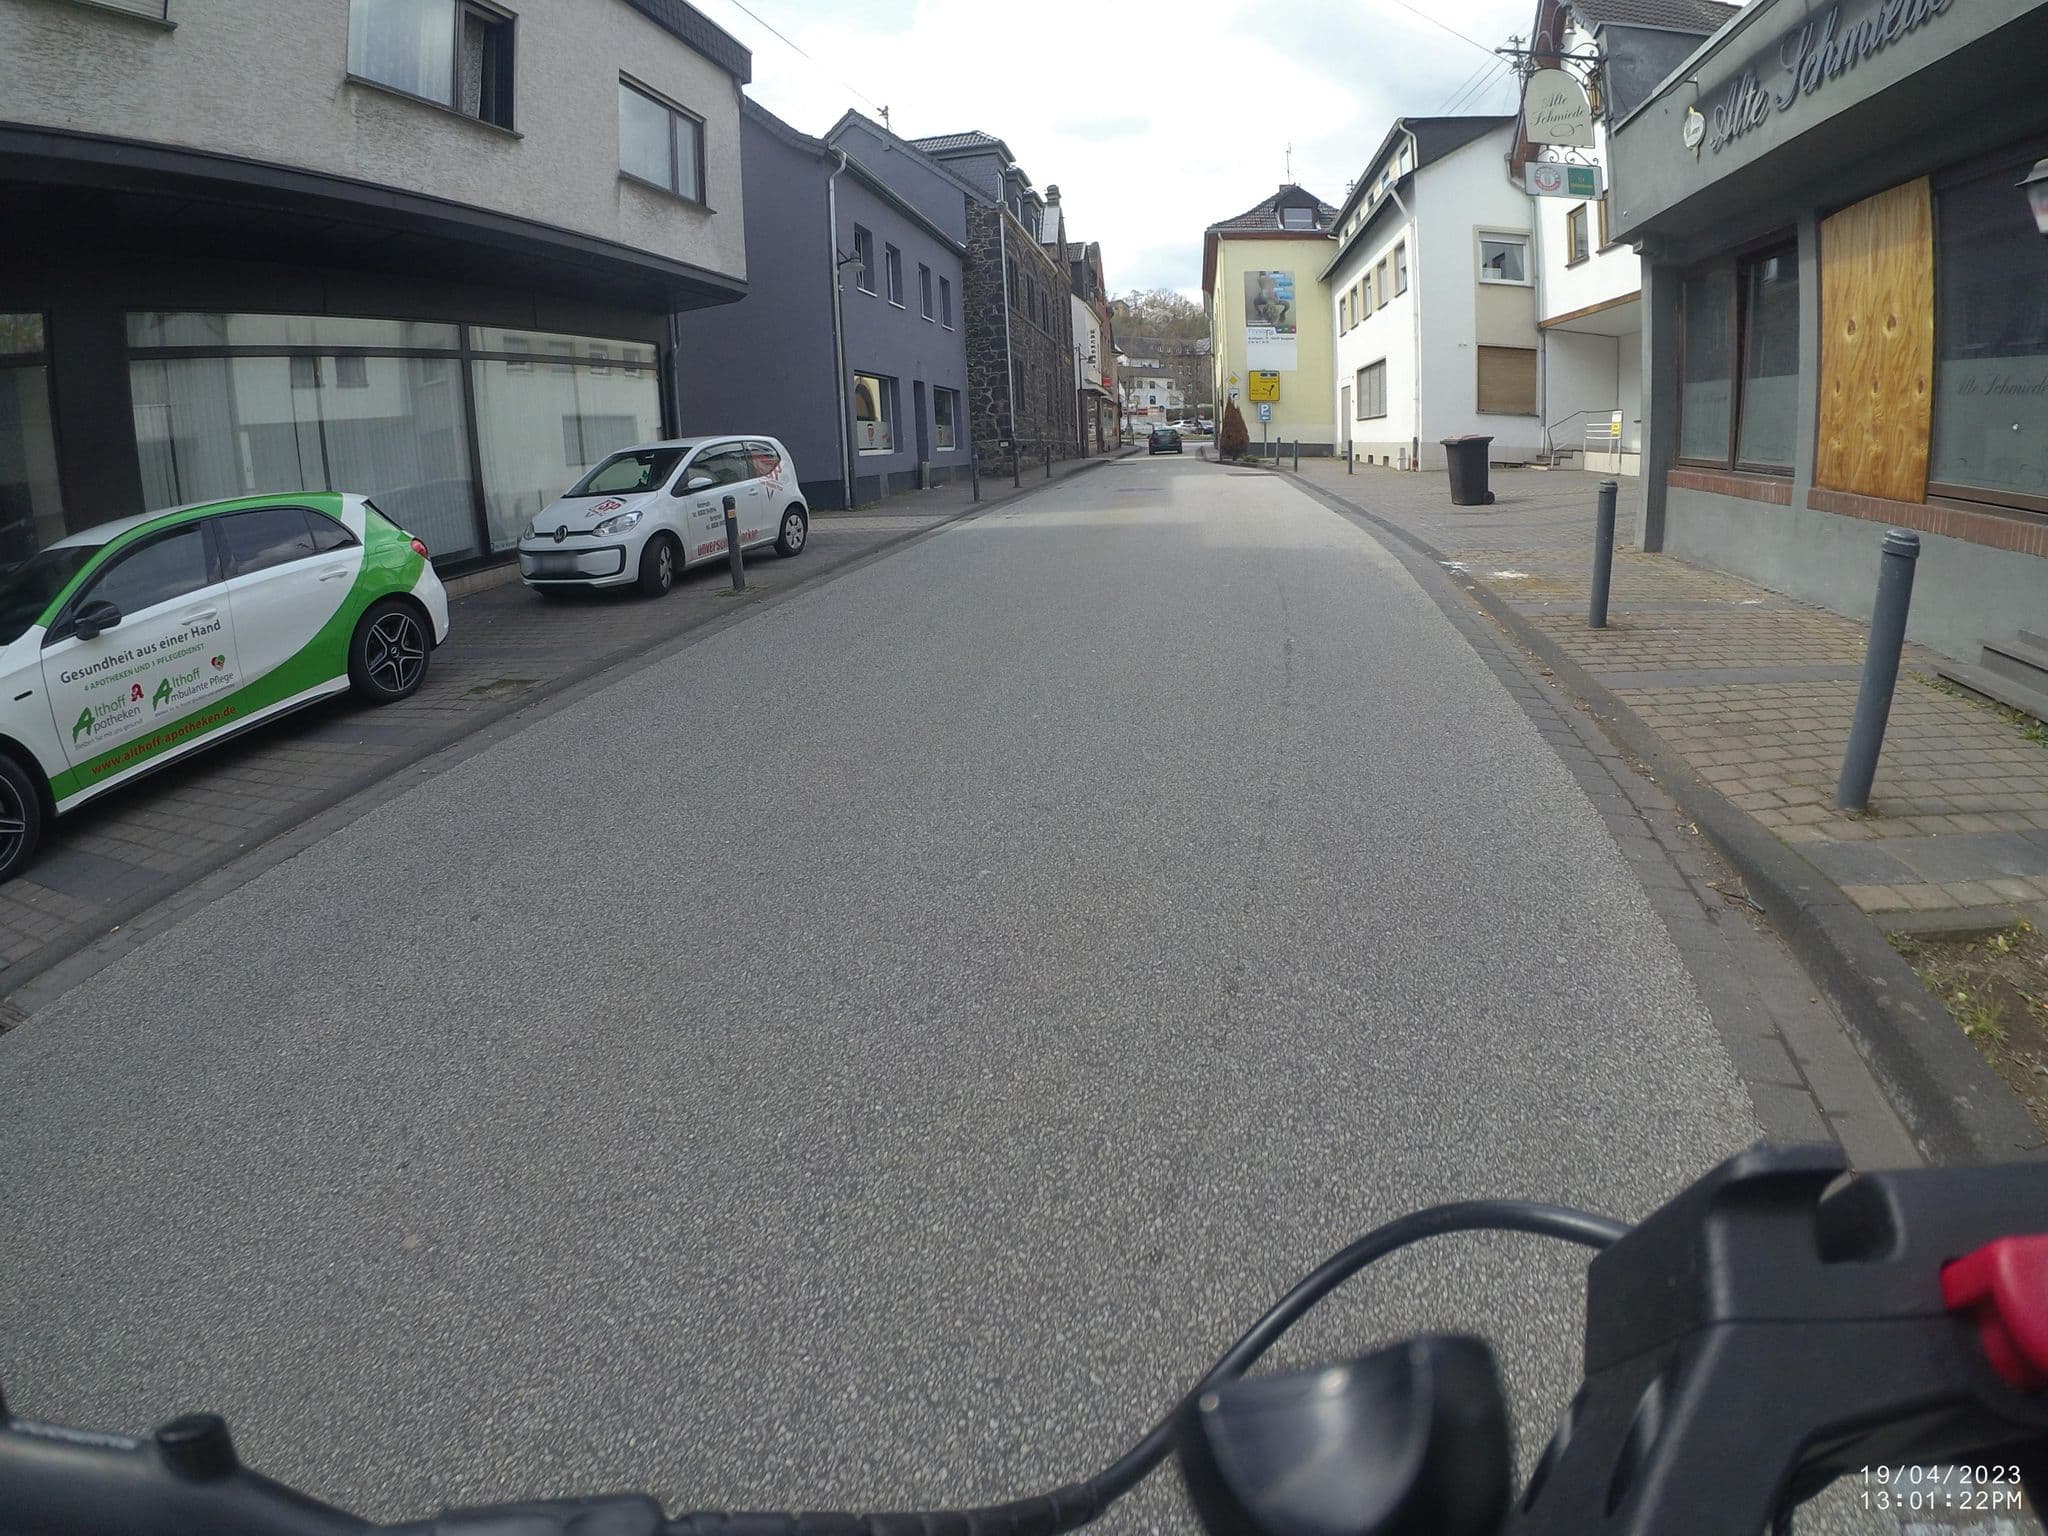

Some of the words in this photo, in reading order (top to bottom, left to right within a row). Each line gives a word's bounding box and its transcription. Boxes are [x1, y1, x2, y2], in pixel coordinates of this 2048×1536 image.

[1530, 105, 1585, 127] Schmiede
[1543, 91, 1568, 110] Alte
[1709, 72, 1769, 152] Alte
[60, 650, 134, 684] Gesundheit
[136, 643, 157, 658] aus
[159, 633, 188, 650] einer
[191, 619, 222, 640] Hand
[90, 668, 134, 690] APOTHEKEN
[135, 663, 150, 676] UND
[156, 642, 205, 666] PFLEGEDIENST
[152, 667, 201, 712] Althoff
[209, 670, 234, 690] Pflege
[72, 694, 127, 744] Althoff
[91, 705, 237, 775] www.althoff-apotheken.de
